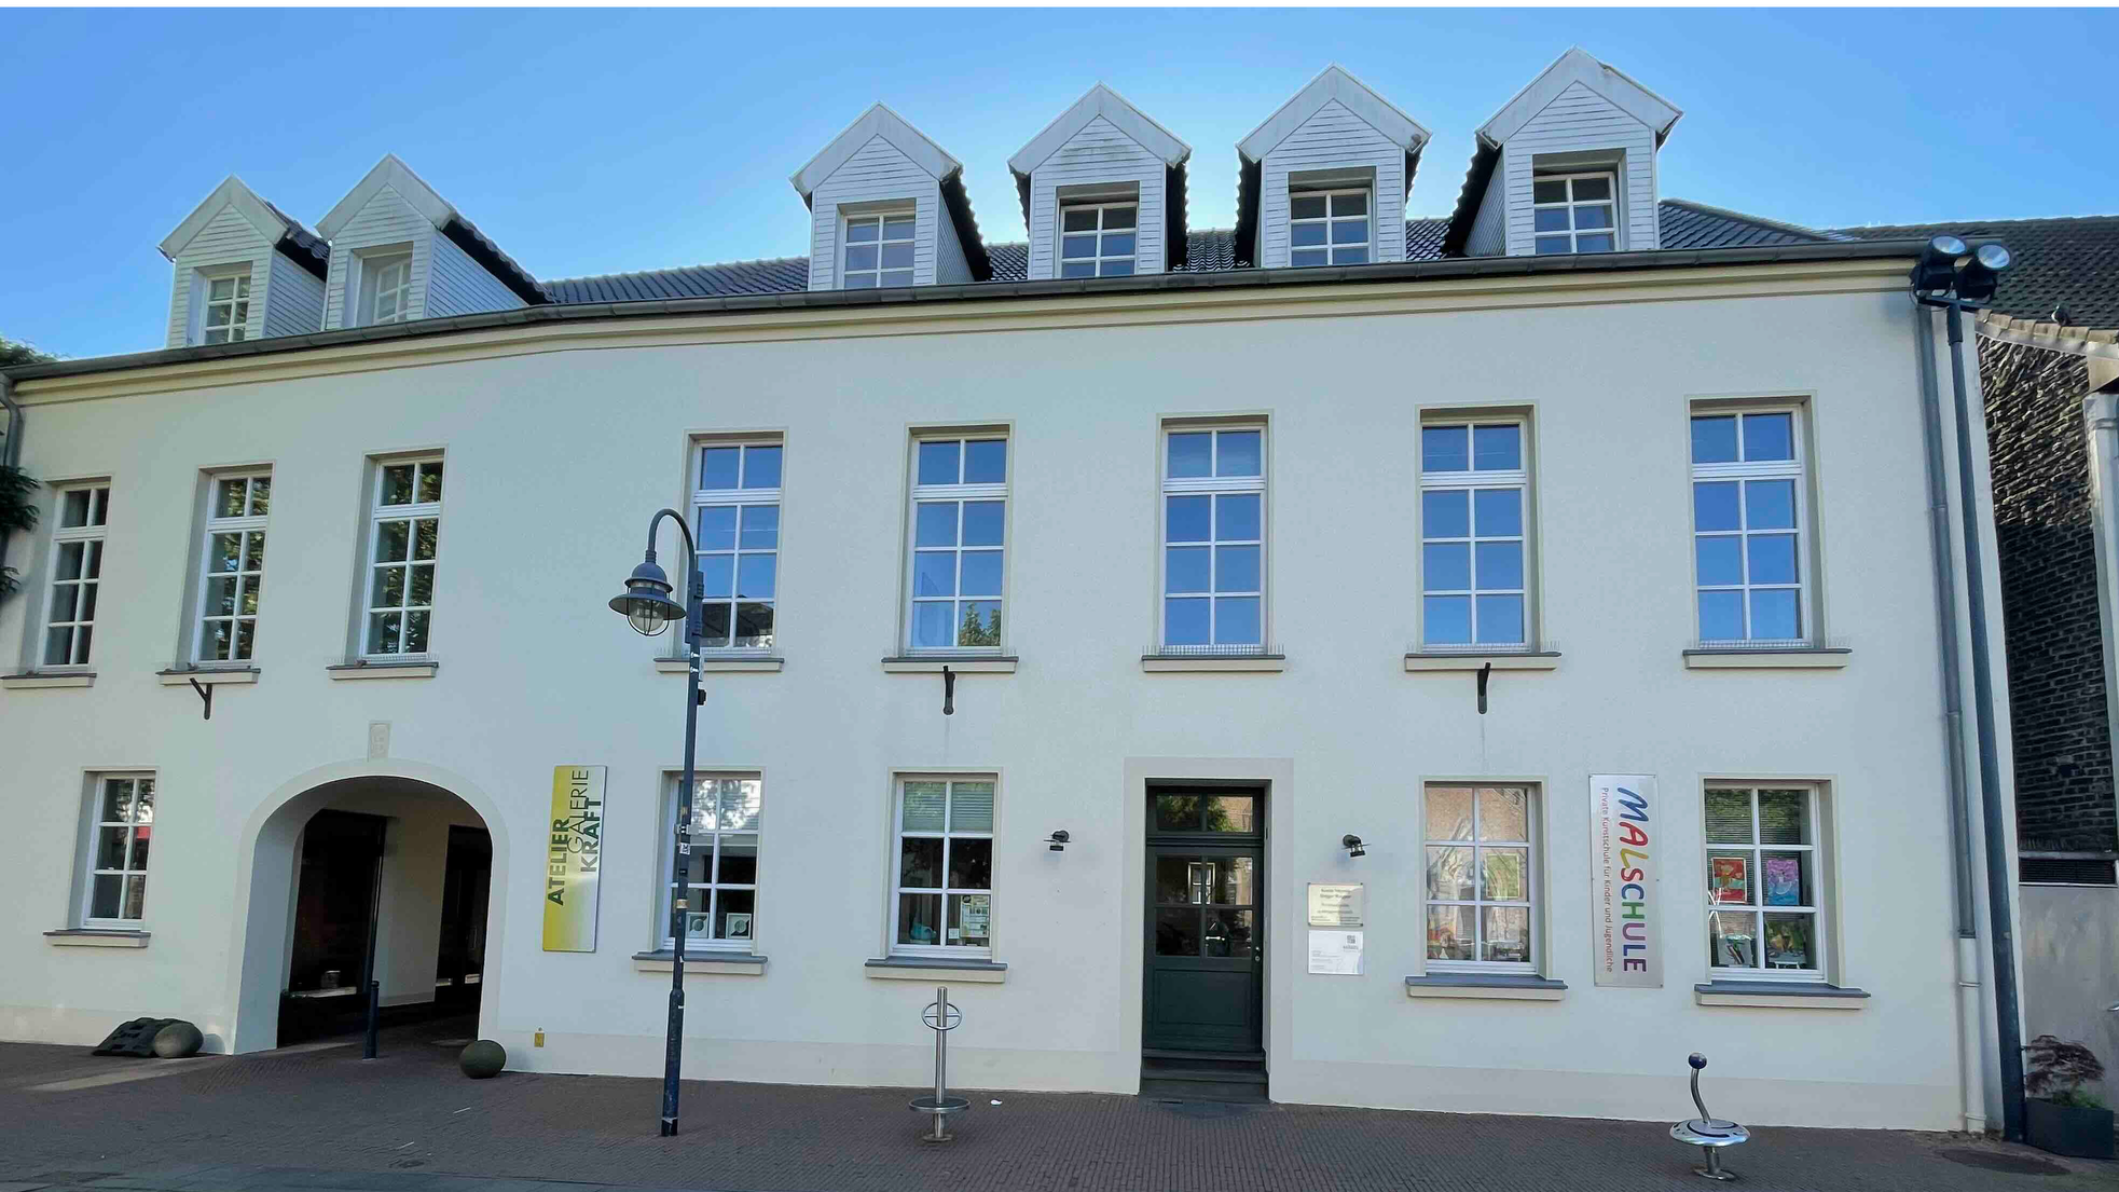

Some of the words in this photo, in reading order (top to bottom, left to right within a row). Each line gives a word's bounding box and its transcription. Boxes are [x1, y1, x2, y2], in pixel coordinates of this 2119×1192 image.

[566, 770, 589, 854] GALERIE
[1601, 787, 1609, 815] Private
[580, 797, 602, 873] KRAFT
[1602, 817, 1610, 864] Kunstschule
[547, 818, 570, 906] ATELIER
[1616, 787, 1650, 973] MALSCHULE
[1603, 880, 1612, 905] Kinder
[1604, 907, 1613, 923] und
[1603, 925, 1614, 973] Jugendliche
